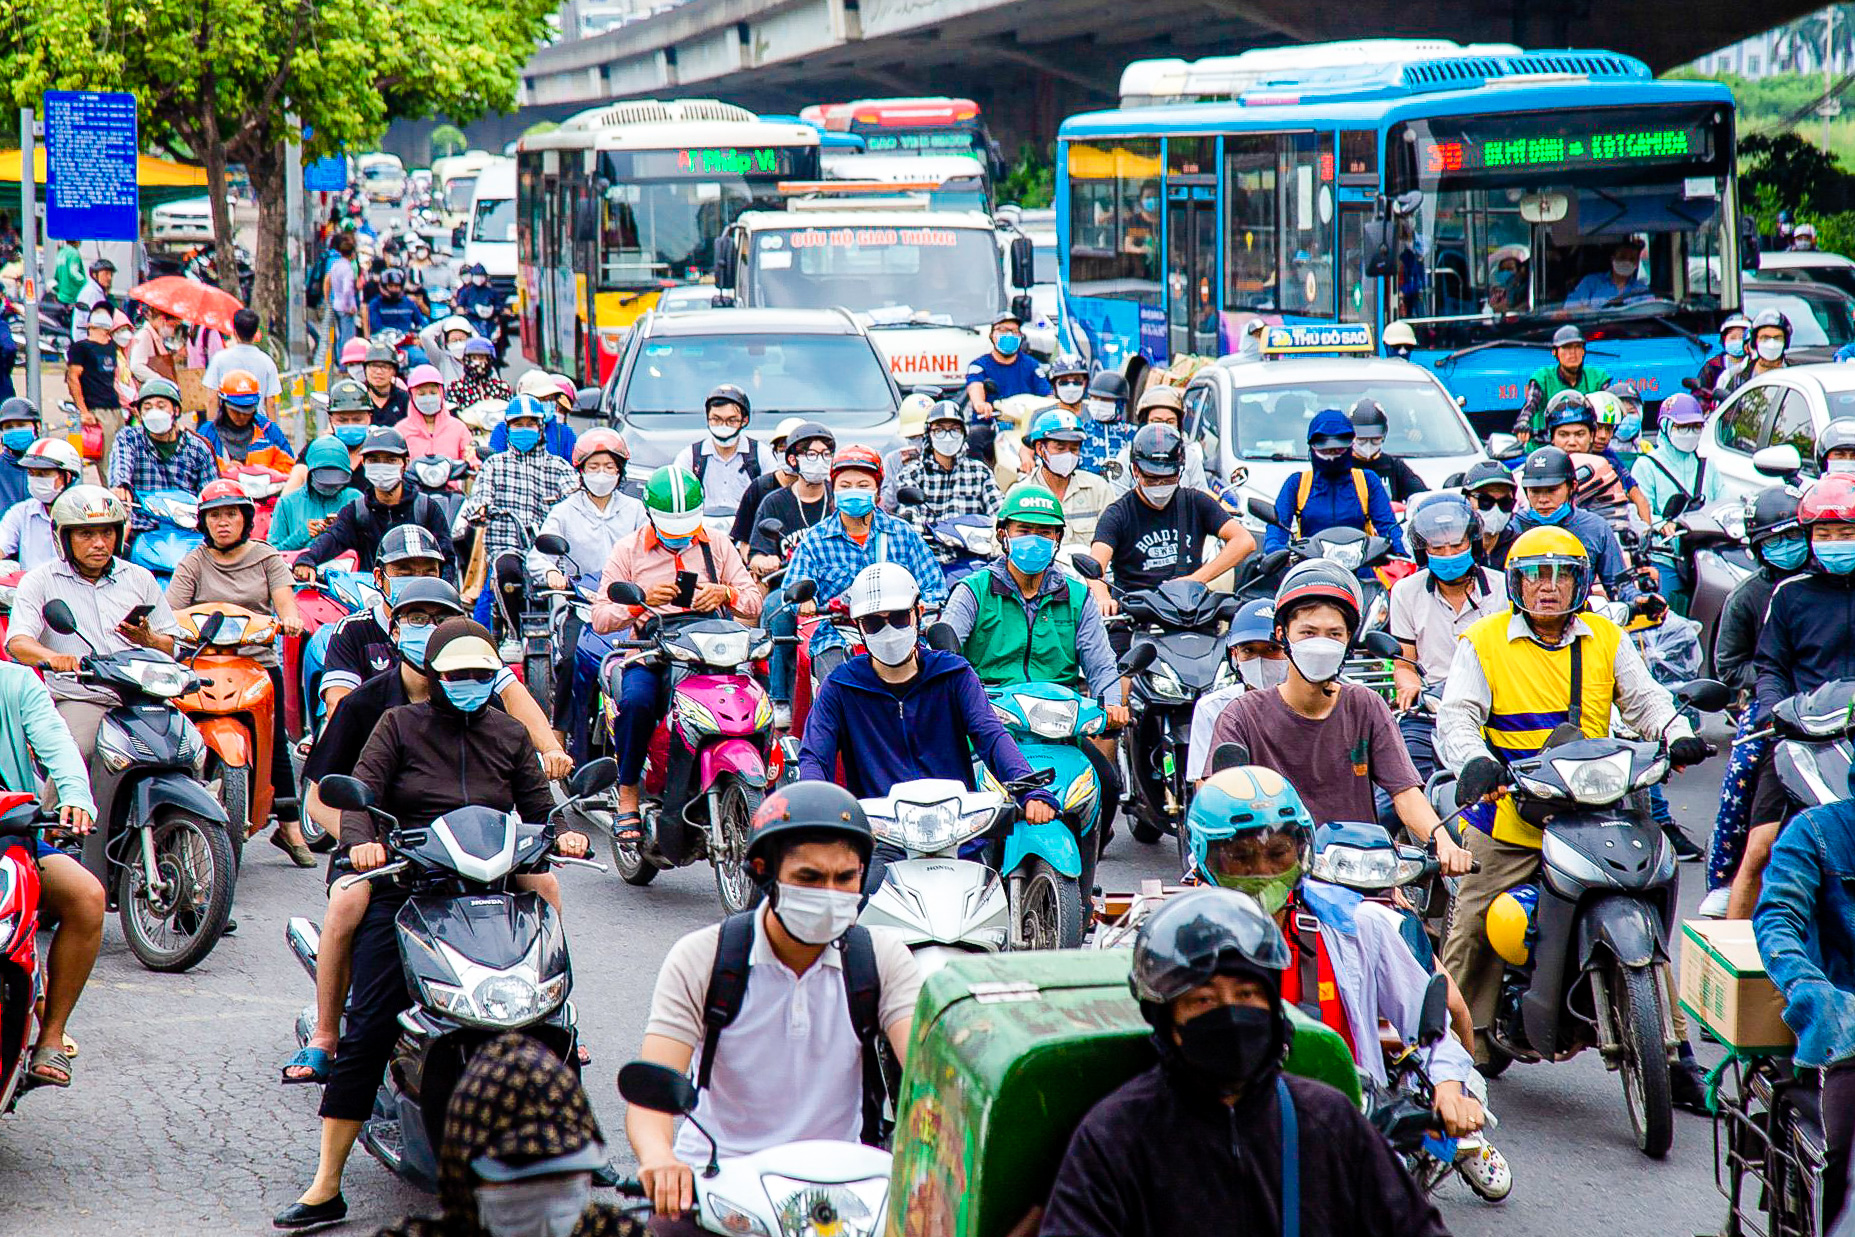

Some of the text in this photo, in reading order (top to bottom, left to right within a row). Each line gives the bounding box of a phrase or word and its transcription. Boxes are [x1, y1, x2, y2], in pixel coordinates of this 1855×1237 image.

[1341, 330, 1368, 344] SAO
[891, 350, 959, 372] KHÁNH
[1135, 529, 1171, 554] ROAD
[926, 864, 956, 872] HONDA
